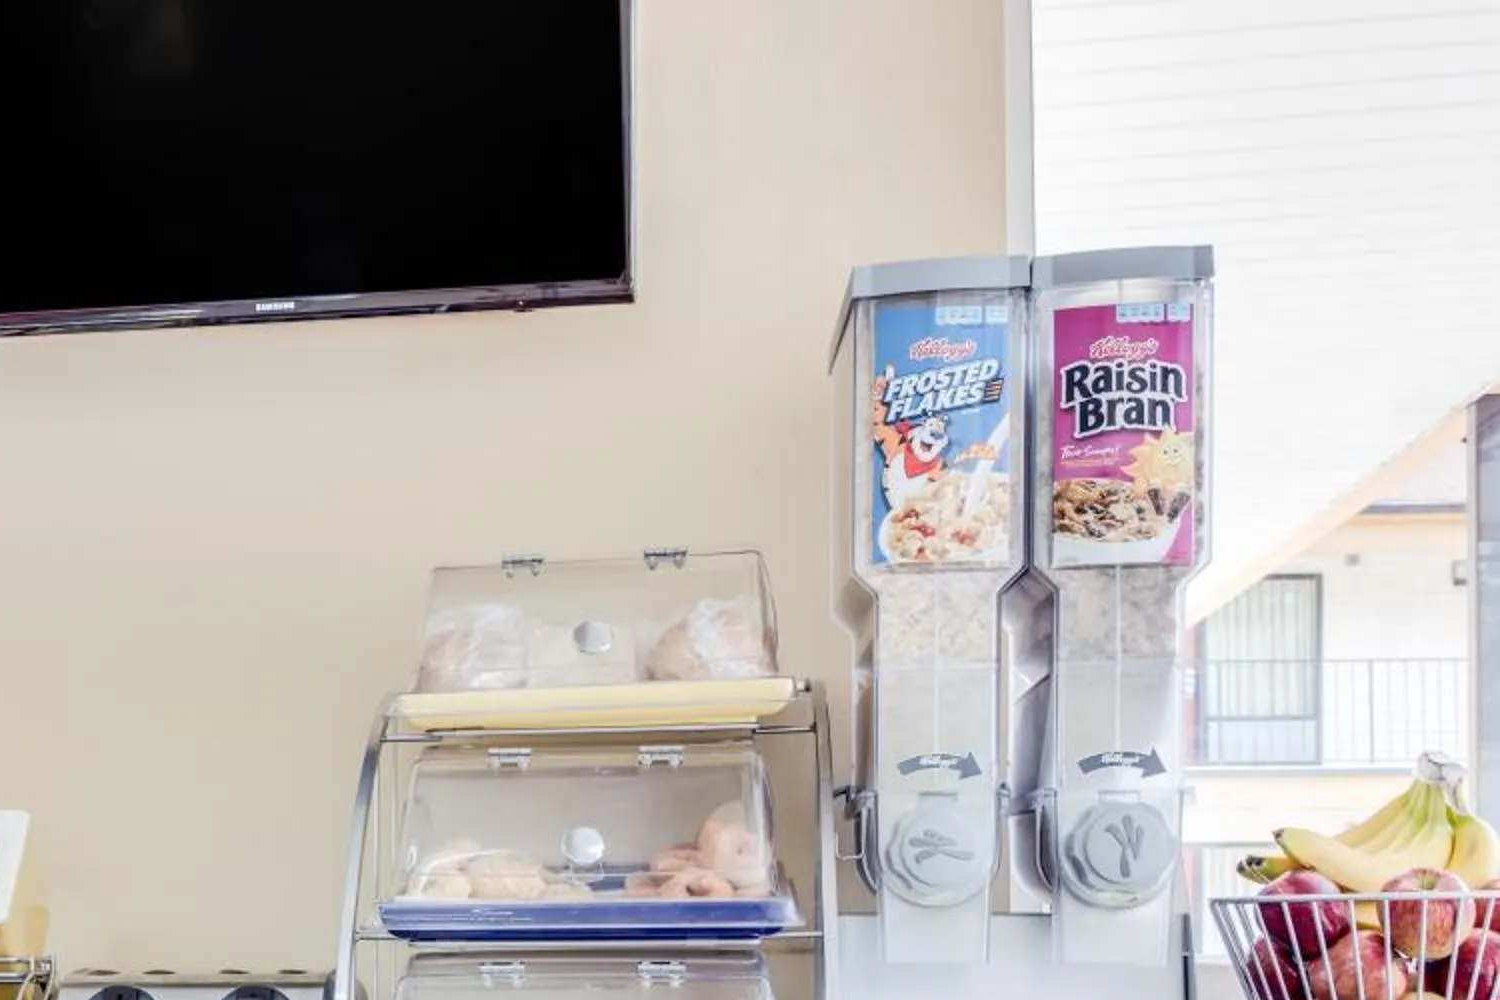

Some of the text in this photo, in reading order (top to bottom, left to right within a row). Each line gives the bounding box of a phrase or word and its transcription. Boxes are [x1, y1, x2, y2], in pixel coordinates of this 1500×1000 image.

[884, 360, 999, 402] FROSTED
[1063, 362, 1184, 404] Raisin
[887, 382, 985, 422] FLAKES
[1078, 397, 1172, 434] Bran
